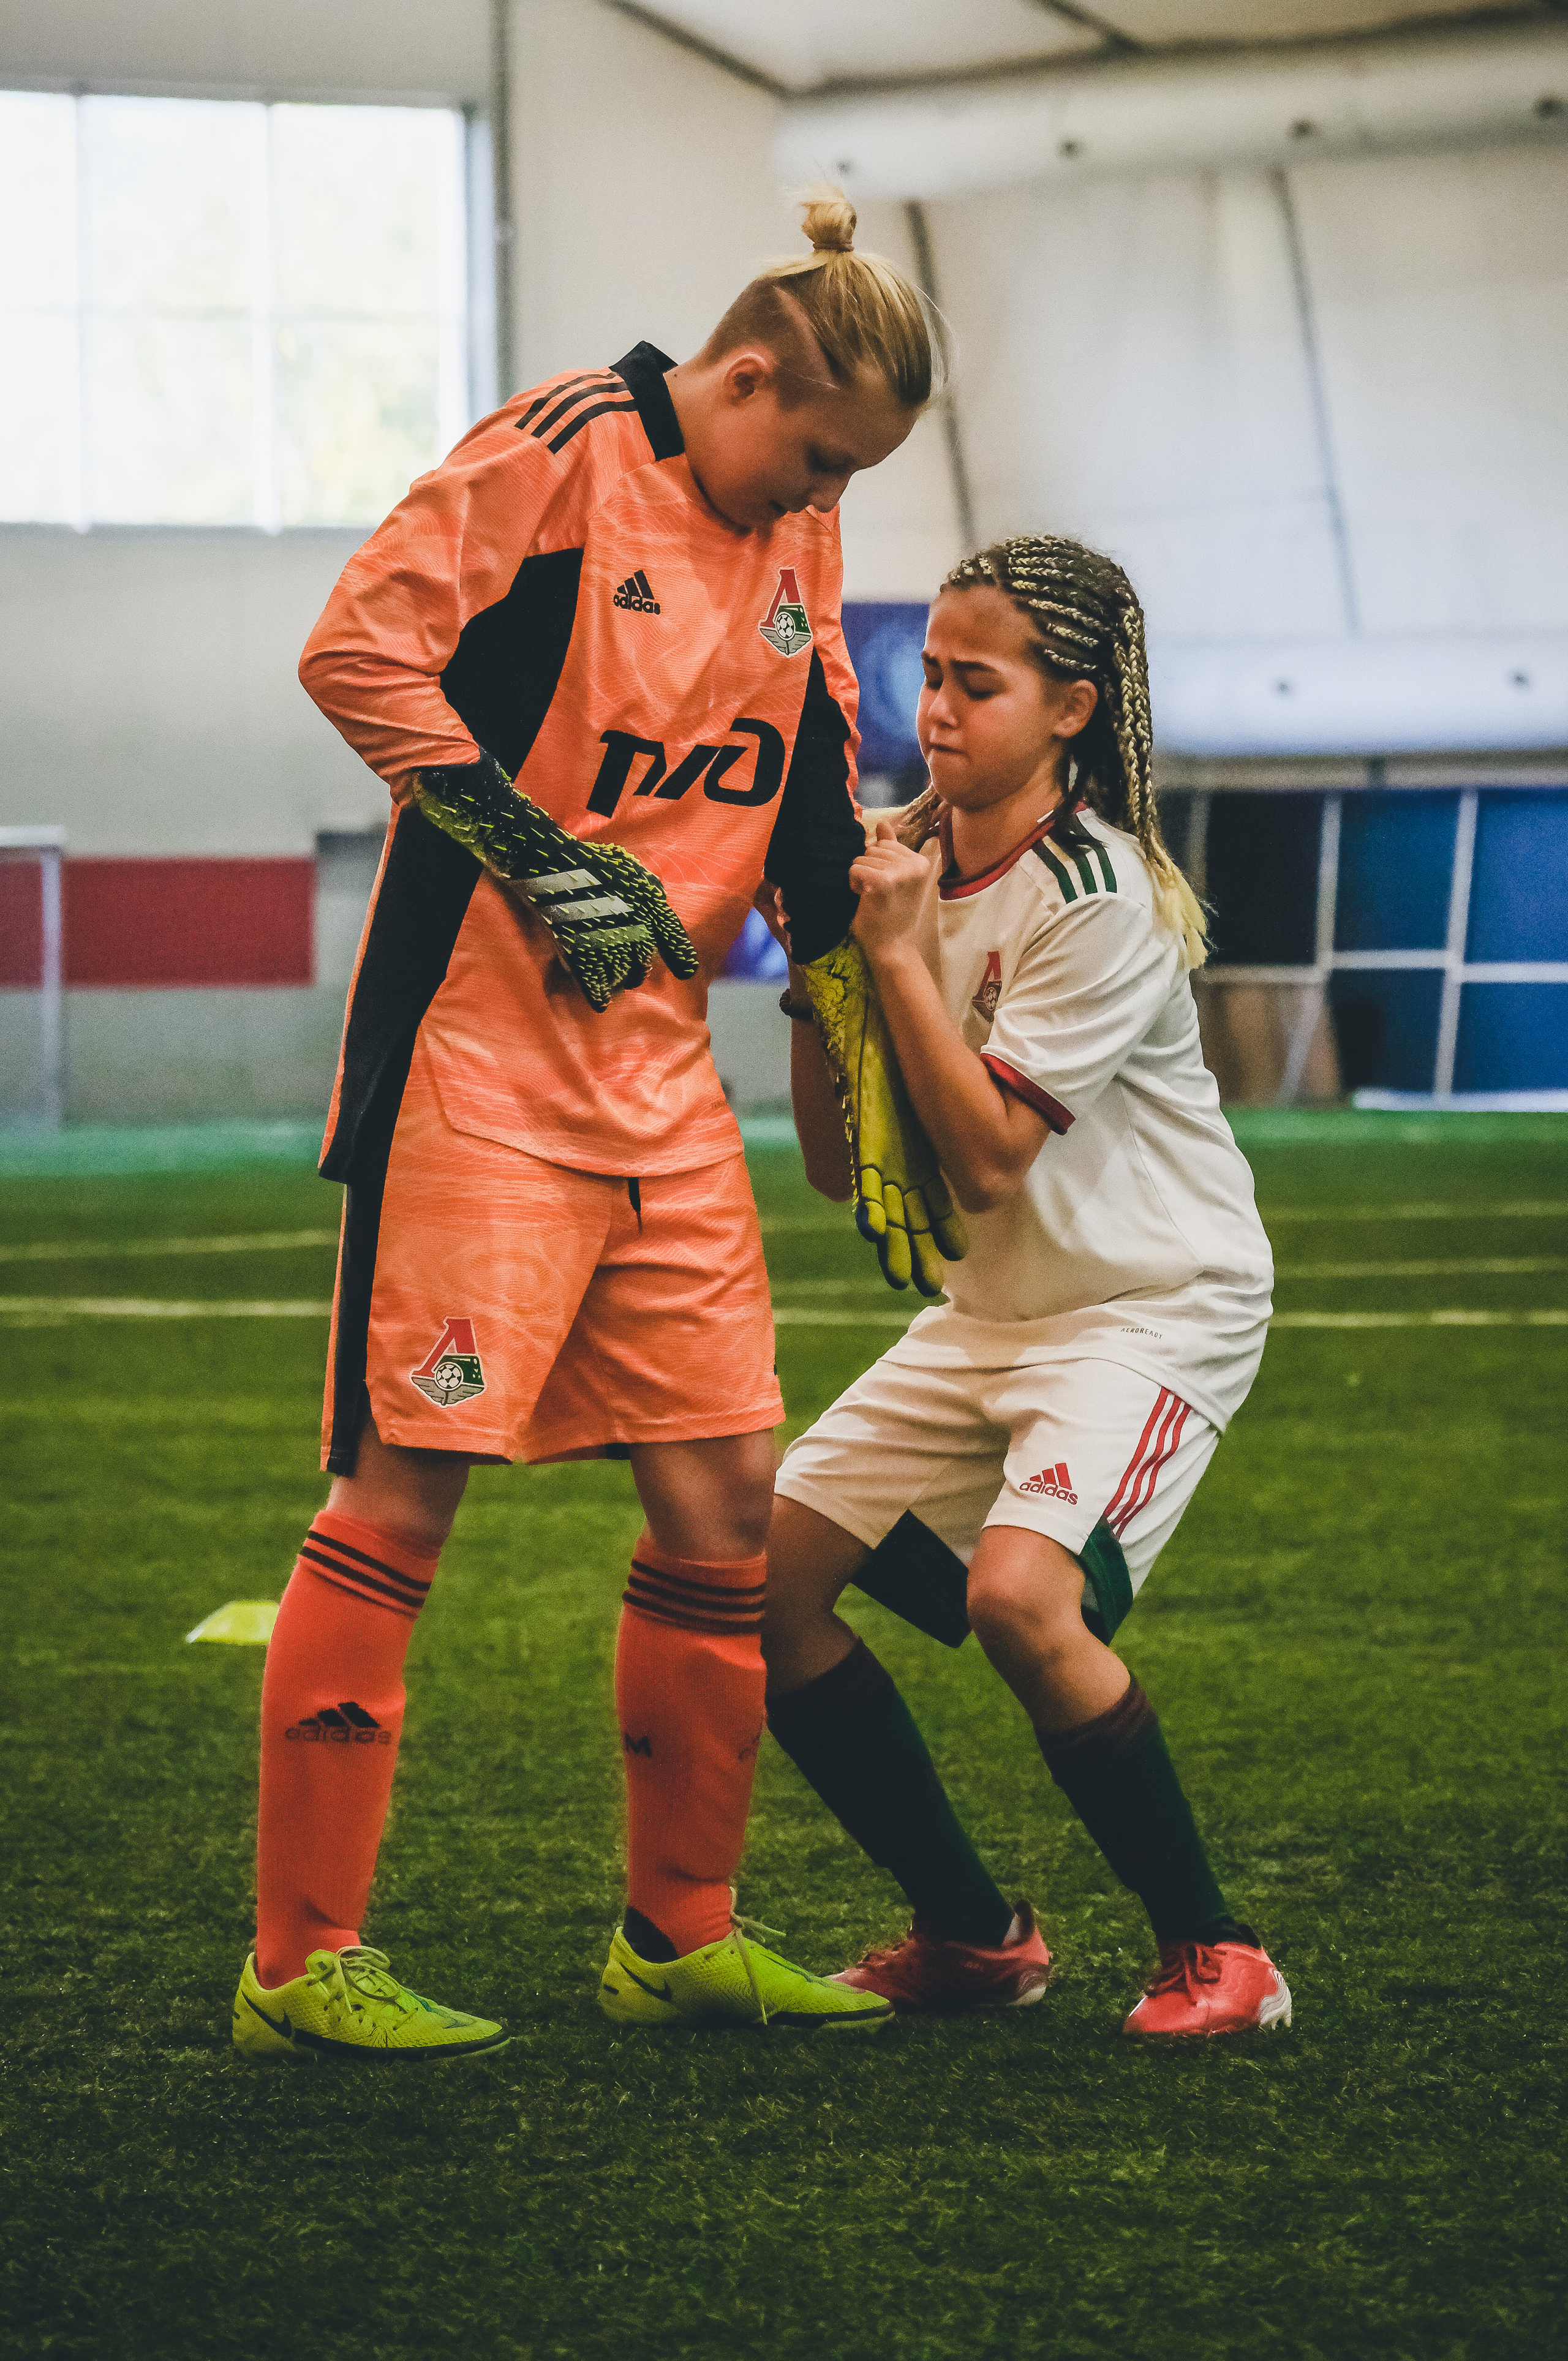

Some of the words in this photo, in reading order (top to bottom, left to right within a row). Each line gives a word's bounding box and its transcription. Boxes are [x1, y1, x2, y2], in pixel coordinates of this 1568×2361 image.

[613, 593, 661, 615] adidas
[1120, 1327, 1163, 1339] AEROREADY
[1019, 1480, 1078, 1505] adidas
[284, 1726, 391, 1745] adidas
